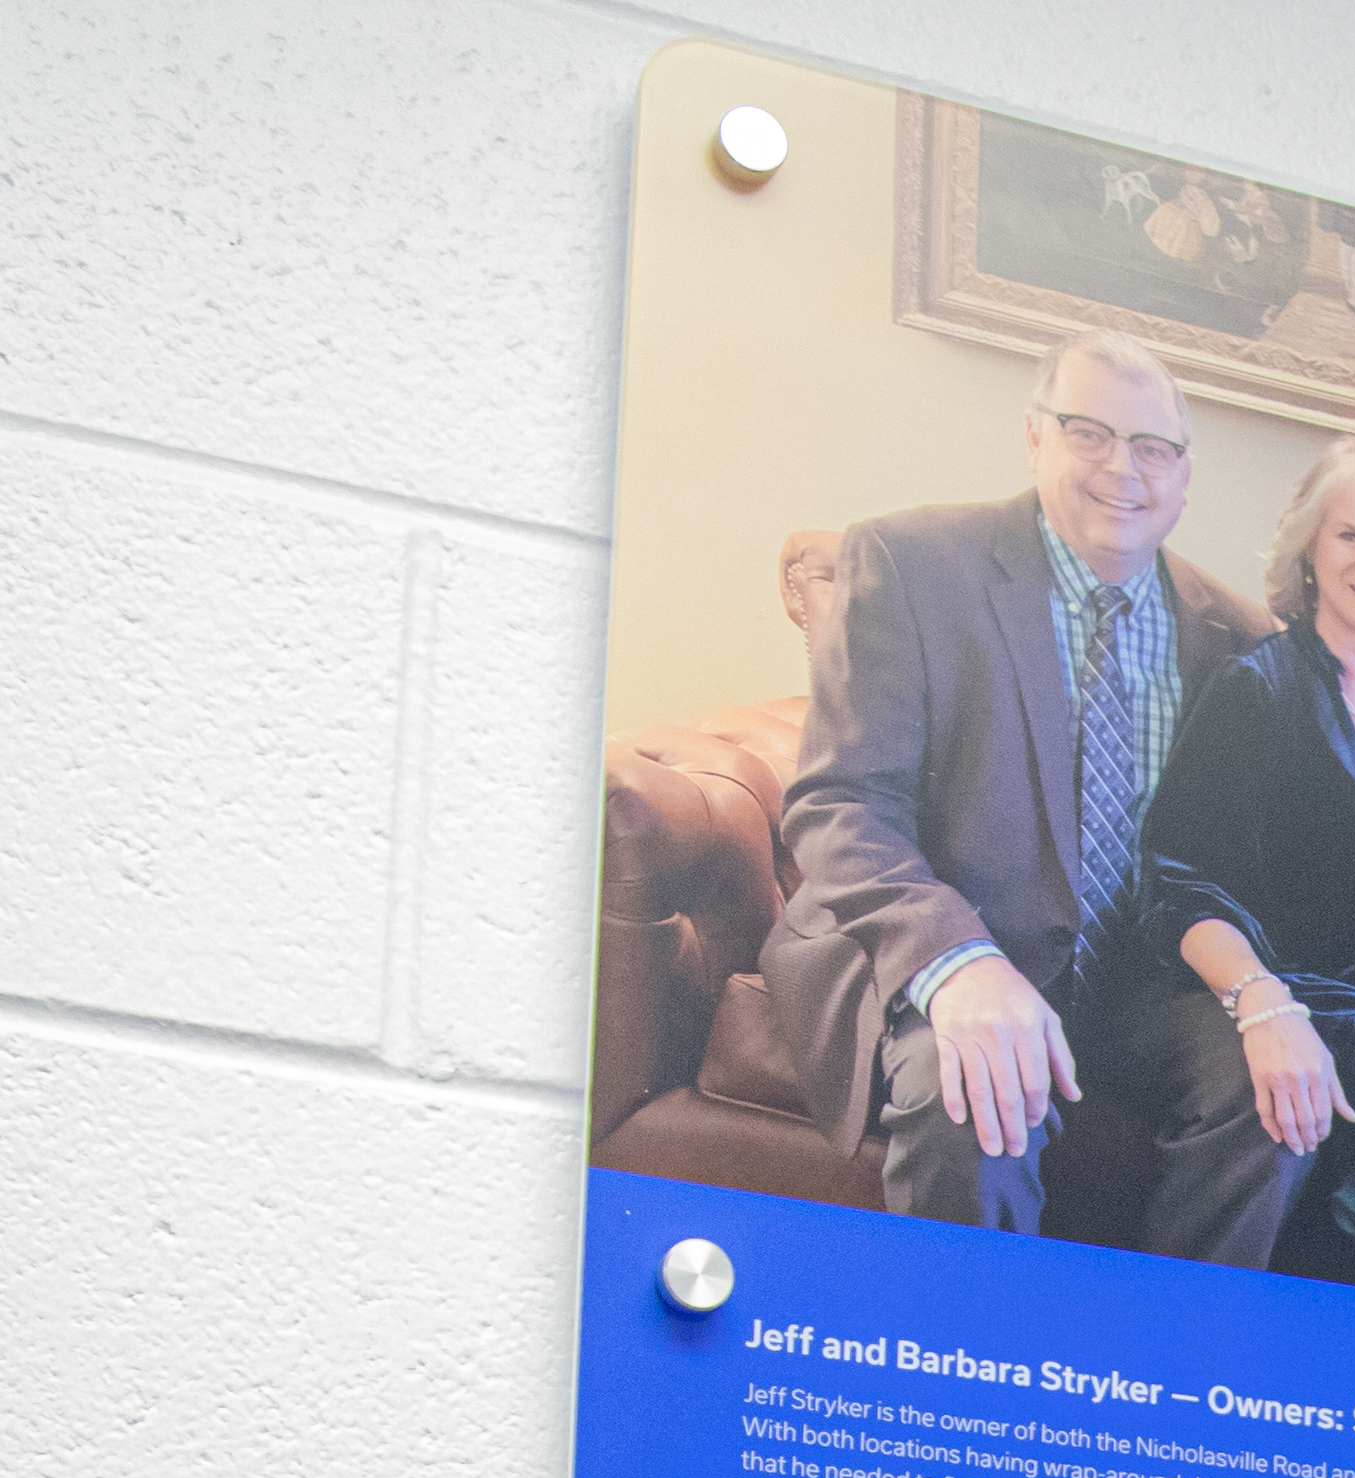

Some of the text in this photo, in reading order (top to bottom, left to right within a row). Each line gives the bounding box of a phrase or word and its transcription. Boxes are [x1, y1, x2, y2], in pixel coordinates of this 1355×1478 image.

[743, 1317, 815, 1357] Jeff
[821, 1335, 888, 1368] and
[896, 1338, 1032, 1388] Barbara
[1039, 1359, 1165, 1406] Stryker
[1206, 1384, 1345, 1432] Owners:
[741, 1415, 798, 1443] With
[802, 1423, 855, 1451] both
[859, 1430, 962, 1465] locations
[743, 1381, 788, 1408] Jeff
[790, 1387, 874, 1419] Stryker
[876, 1400, 896, 1423] is
[898, 1404, 936, 1428] the
[939, 1413, 1011, 1438] owner
[1013, 1420, 1038, 1442] of
[1040, 1422, 1092, 1449] both
[1094, 1431, 1132, 1455] the
[1135, 1435, 1269, 1474] Nicholasville
